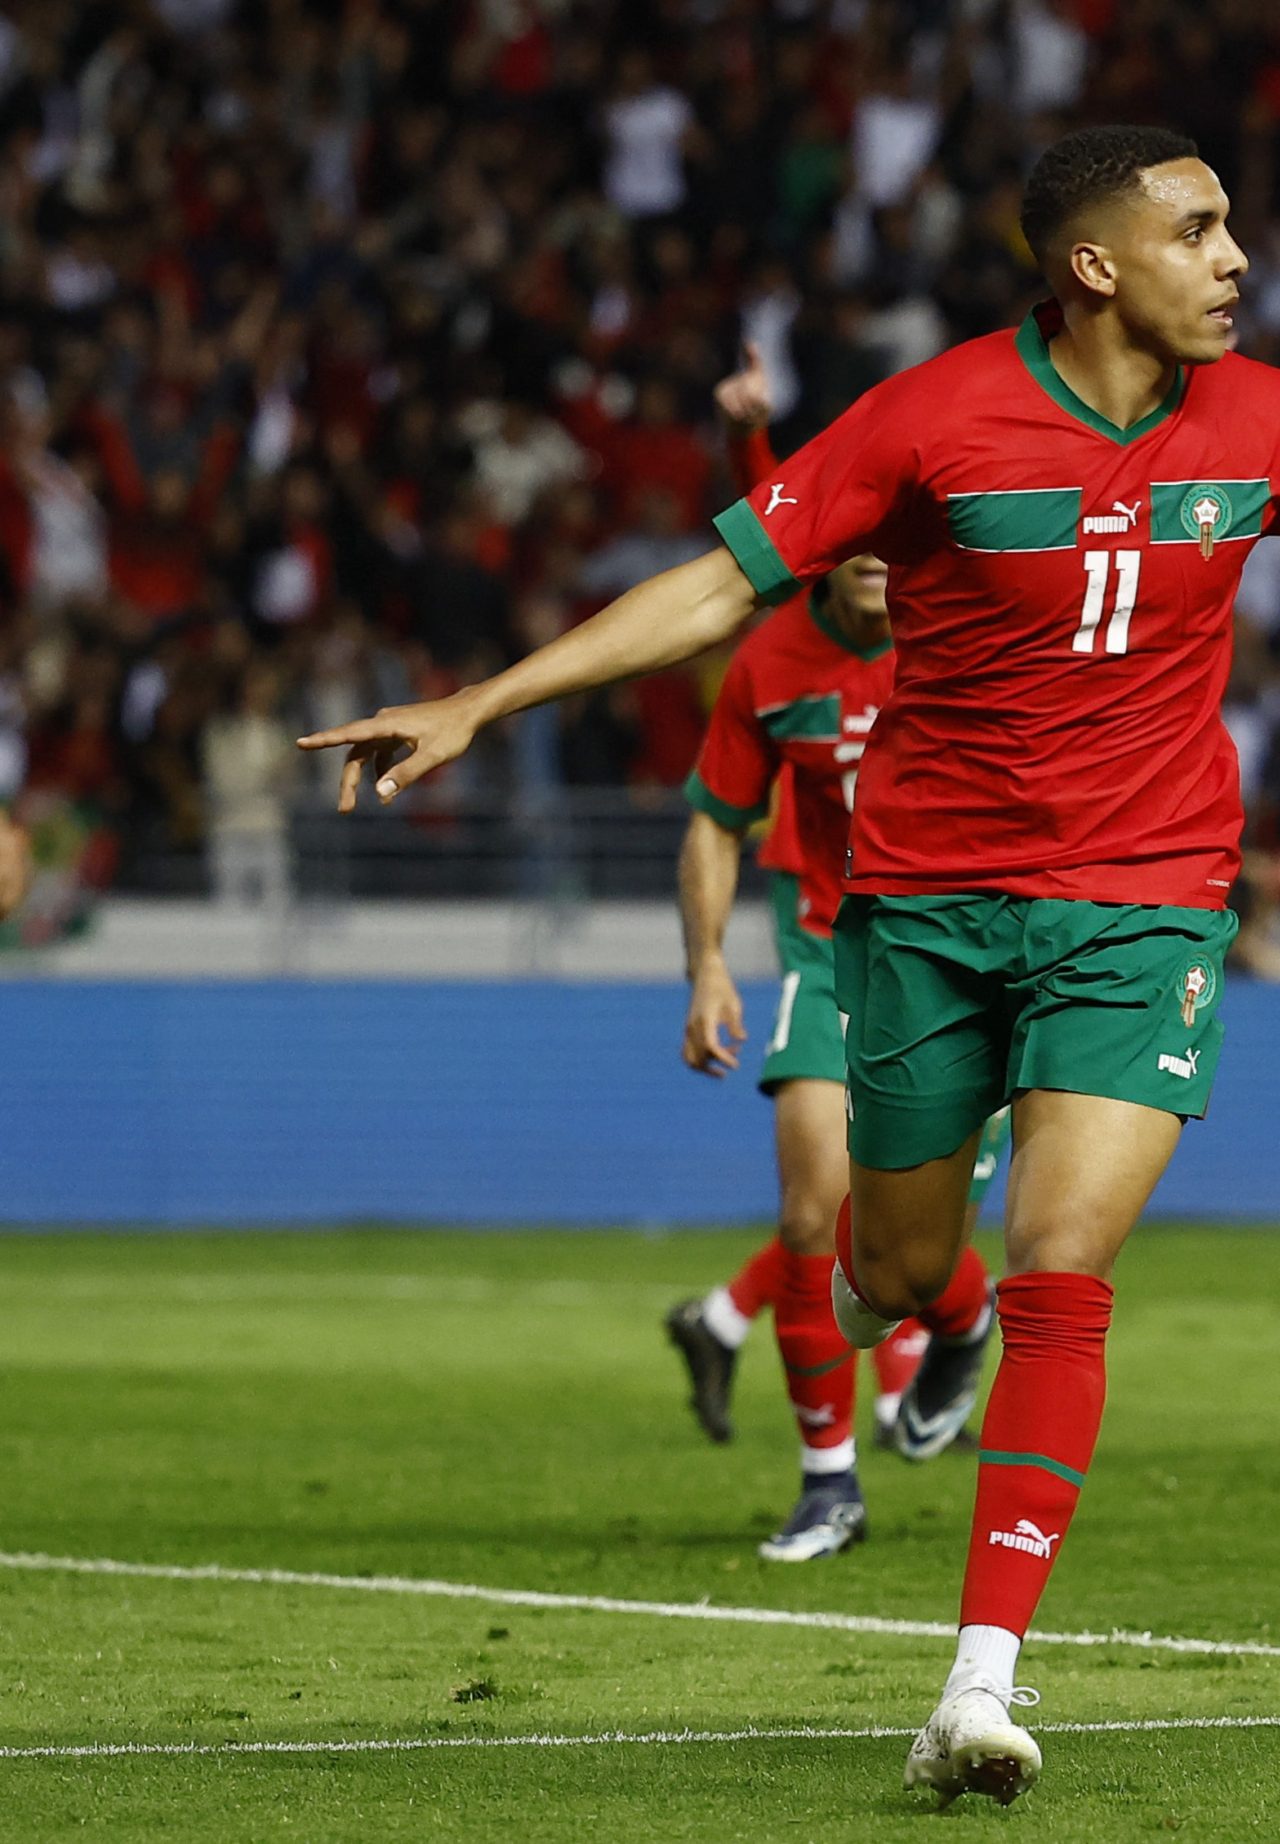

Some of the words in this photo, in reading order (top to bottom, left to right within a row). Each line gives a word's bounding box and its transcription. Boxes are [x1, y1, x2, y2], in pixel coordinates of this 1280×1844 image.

[1083, 515, 1129, 534] PUMA
[1071, 549, 1142, 655] 11
[988, 1530, 1045, 1558] PUMA
